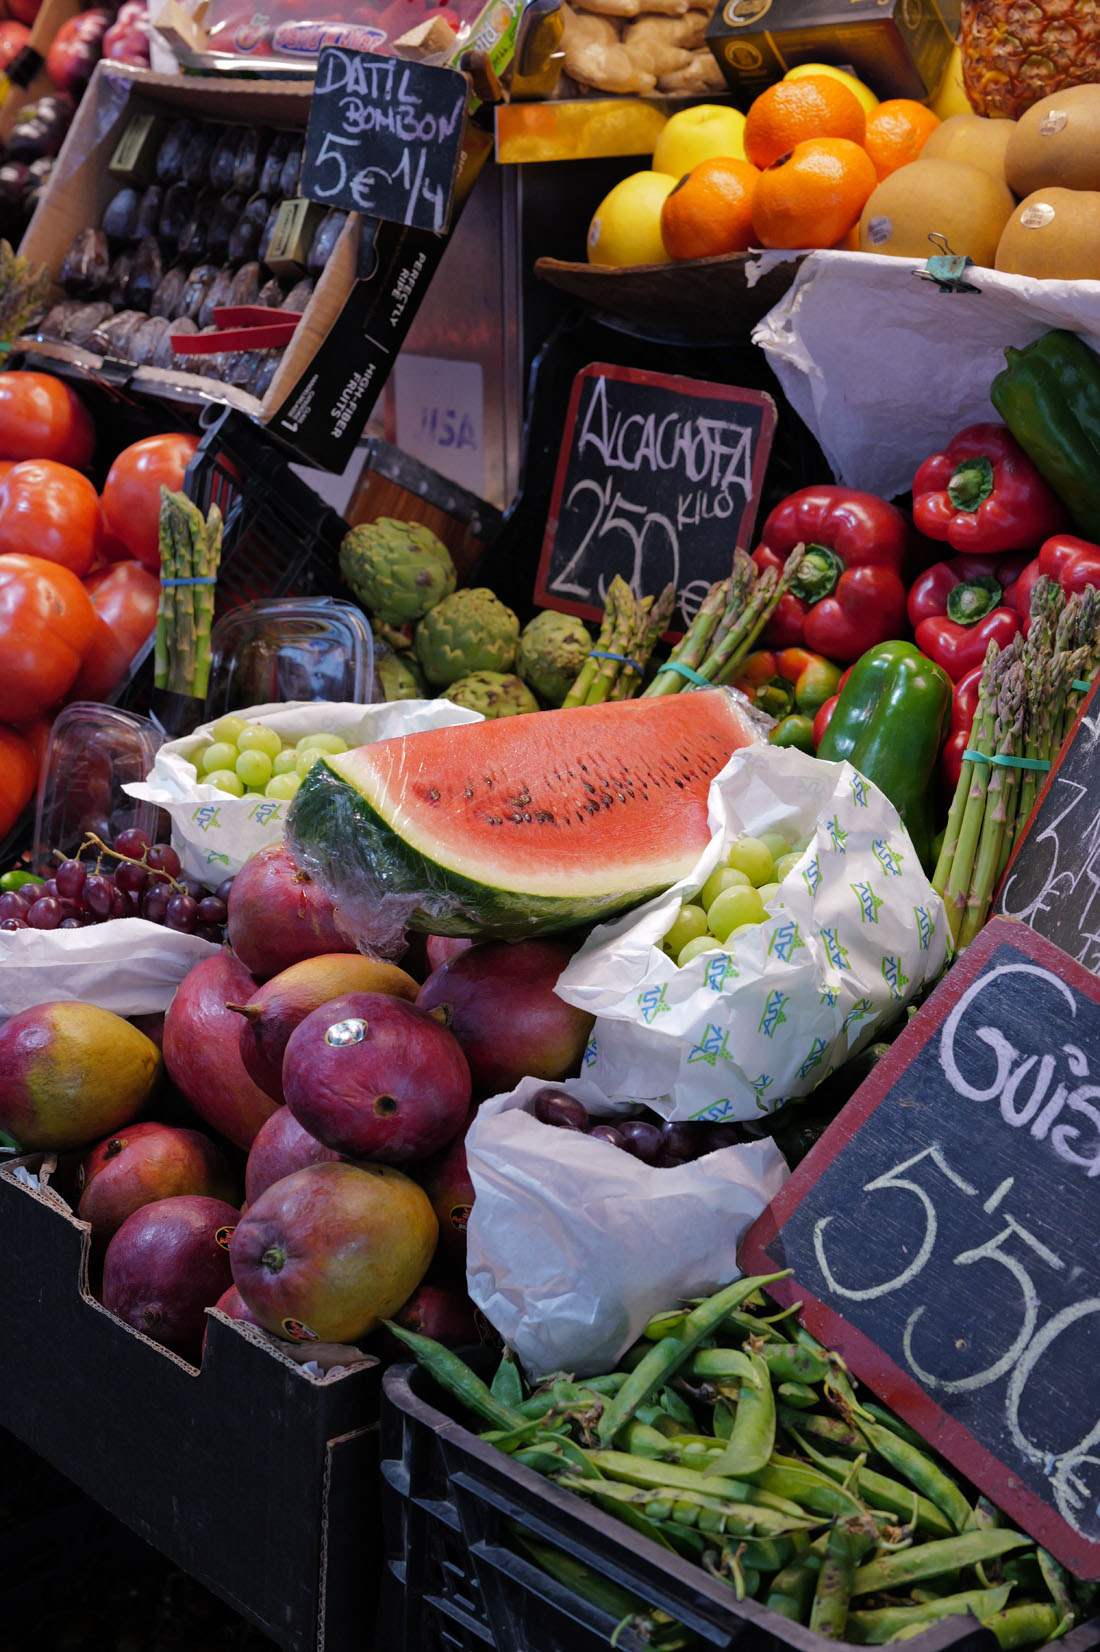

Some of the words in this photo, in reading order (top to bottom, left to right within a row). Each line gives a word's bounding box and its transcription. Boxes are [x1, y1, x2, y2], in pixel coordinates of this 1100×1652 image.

[315, 49, 422, 104] DATIL
[339, 97, 465, 144] BOMBON
[391, 147, 444, 234] 1/4
[390, 252, 427, 327] PERFECTLY
[391, 268, 411, 298] RIPE
[330, 372, 363, 418] FRUITS
[331, 363, 376, 439] HIGH-FIBER
[579, 375, 753, 502] ALCACHOFA
[677, 487, 734, 531] KILO
